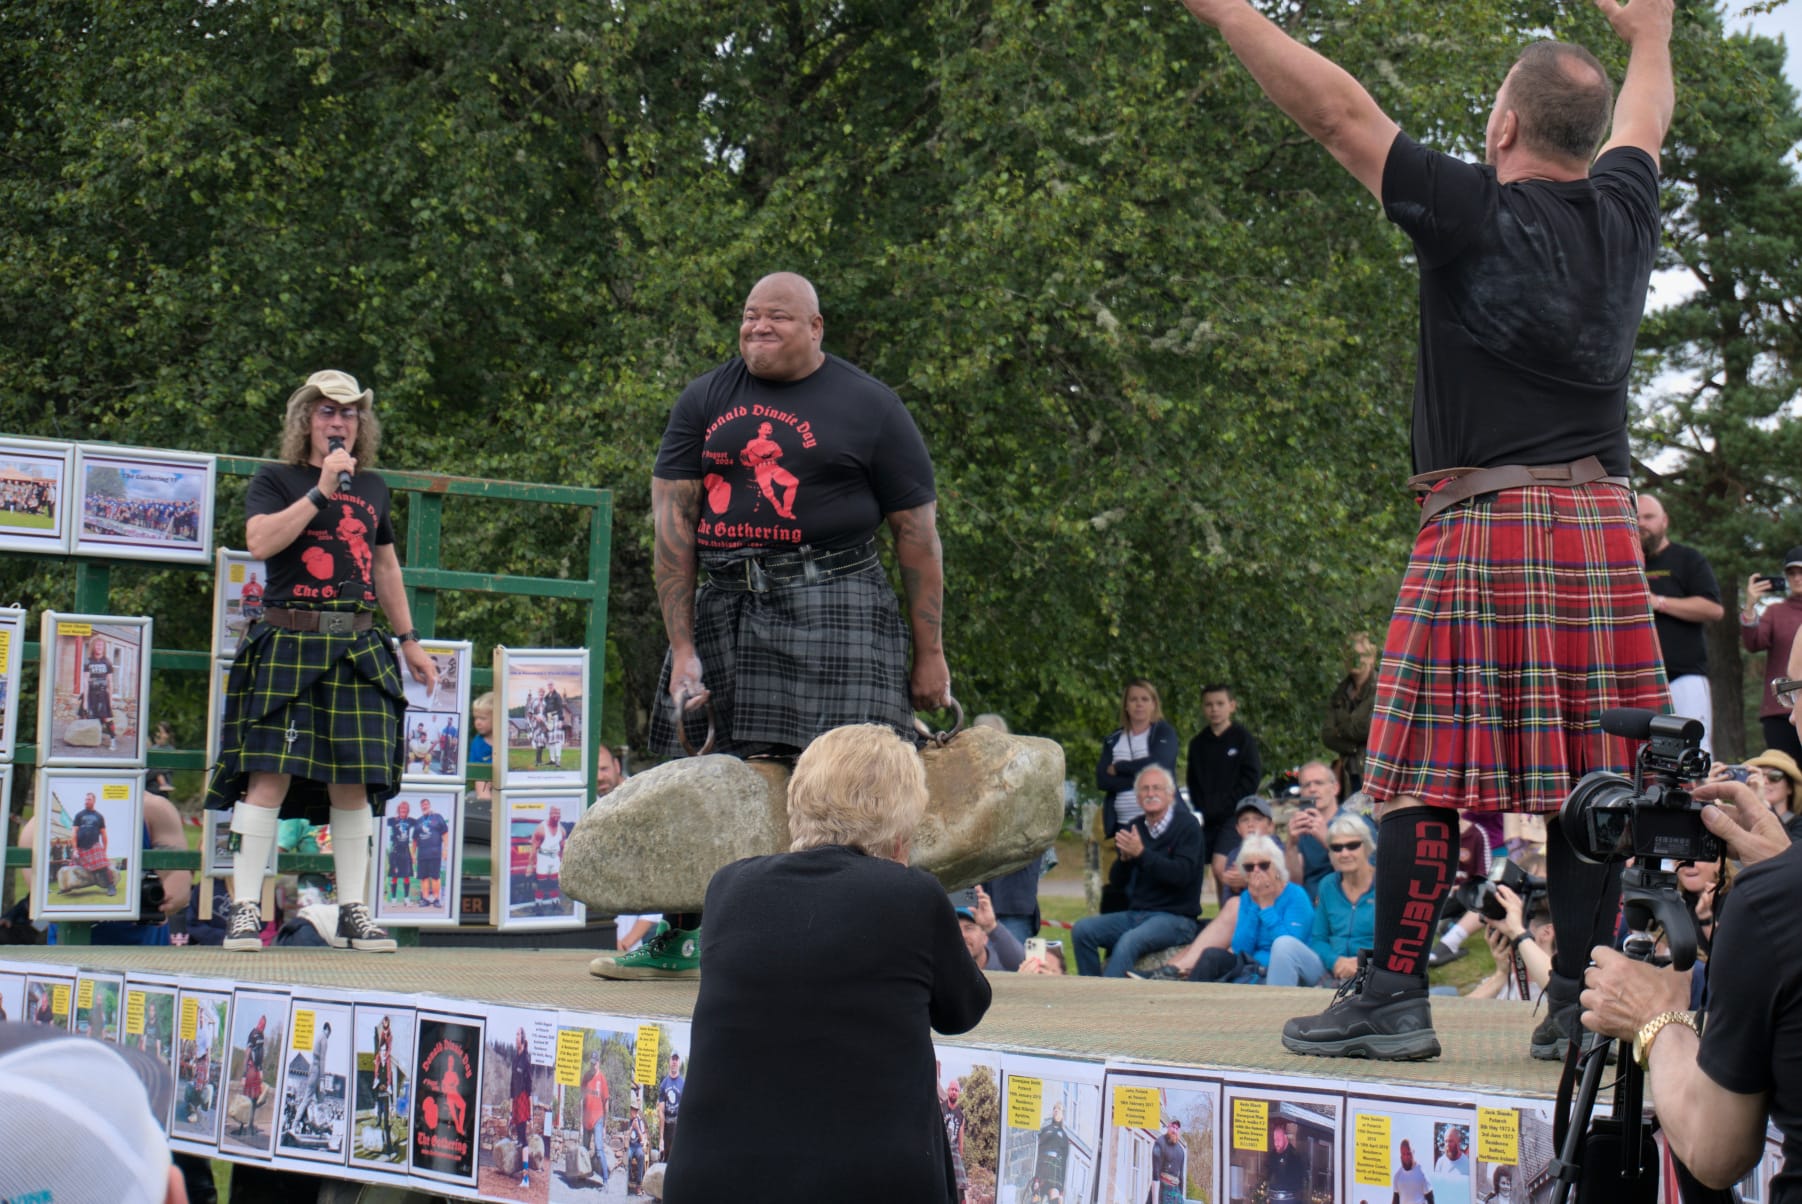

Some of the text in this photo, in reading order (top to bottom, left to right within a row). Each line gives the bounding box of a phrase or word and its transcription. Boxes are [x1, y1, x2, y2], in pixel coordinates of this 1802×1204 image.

[752, 404, 799, 427] Dinnie
[796, 421, 817, 449] Day
[714, 521, 802, 543] Gathering
[293, 584, 319, 598] The
